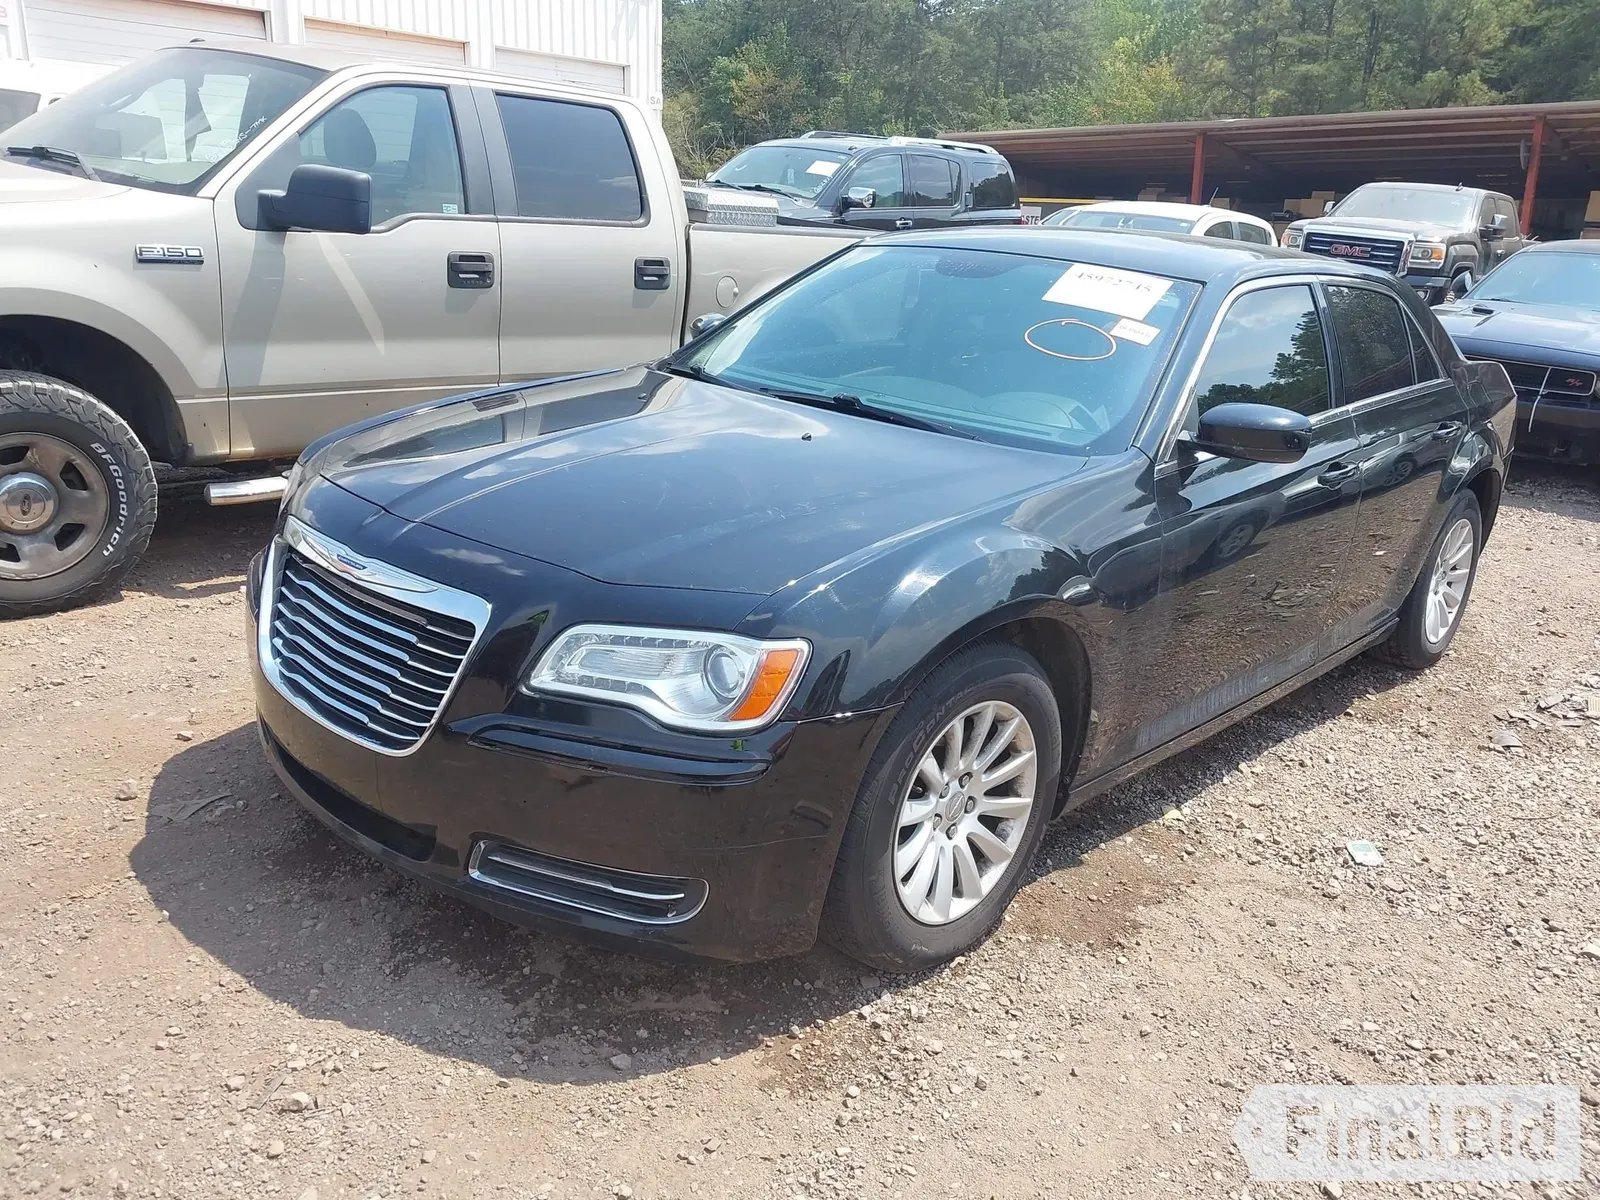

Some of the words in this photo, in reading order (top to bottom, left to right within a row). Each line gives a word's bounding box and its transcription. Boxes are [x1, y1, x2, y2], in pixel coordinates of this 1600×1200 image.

[138, 246, 203, 257] F-150
[1330, 243, 1371, 258] GMC
[90, 441, 129, 558] BFGoodrich
